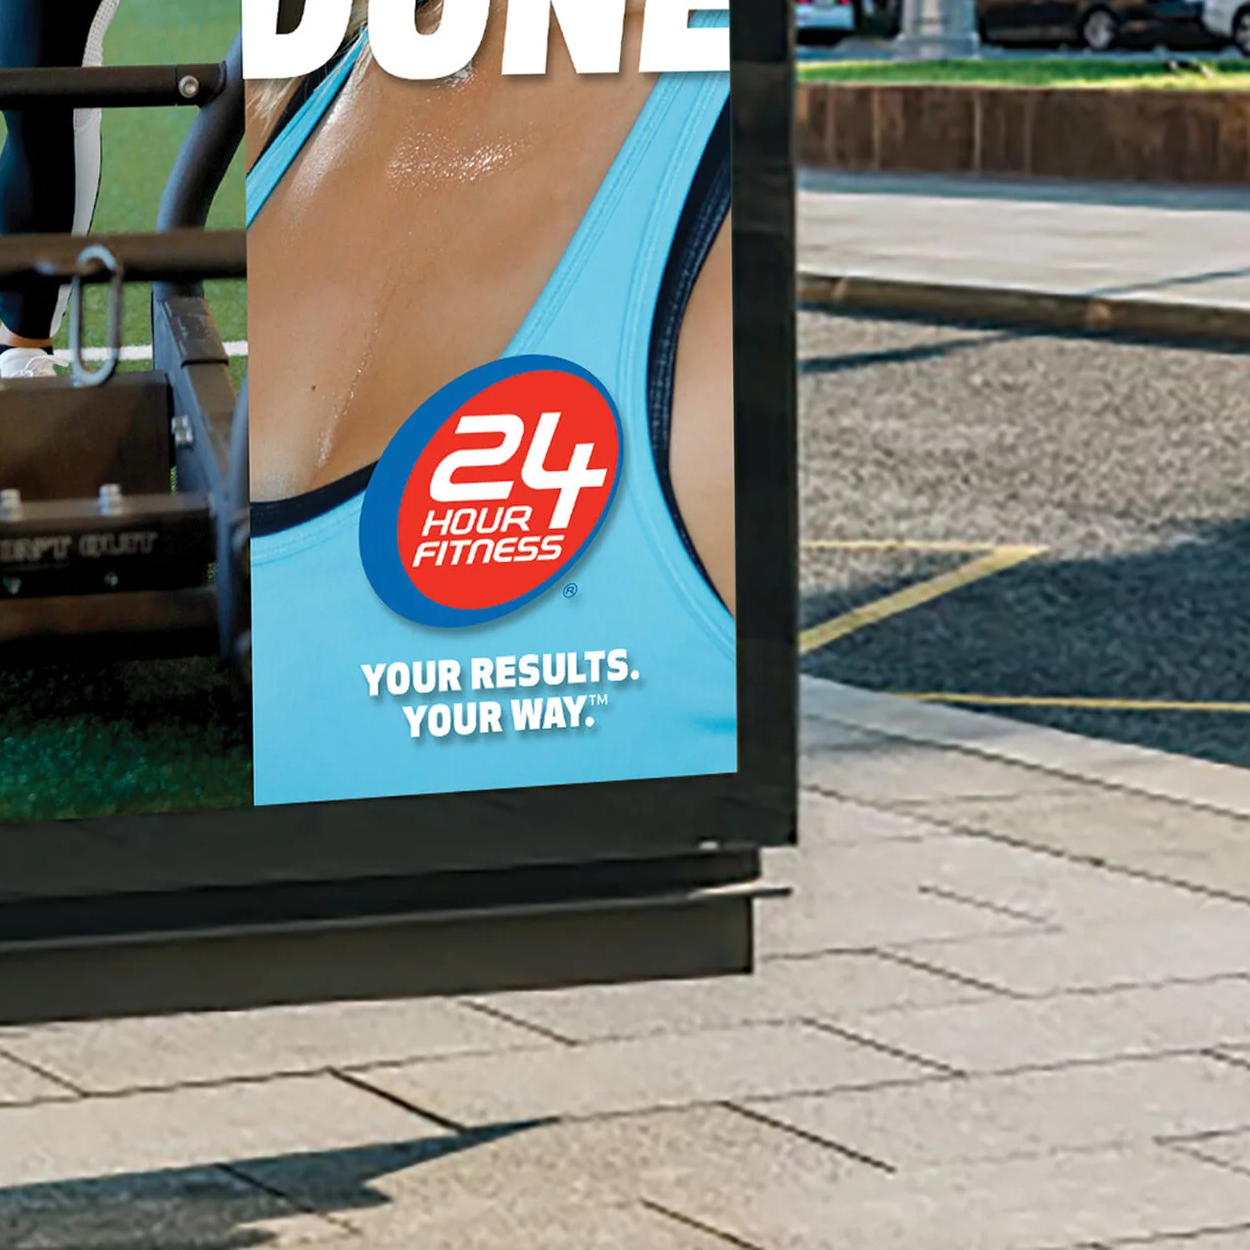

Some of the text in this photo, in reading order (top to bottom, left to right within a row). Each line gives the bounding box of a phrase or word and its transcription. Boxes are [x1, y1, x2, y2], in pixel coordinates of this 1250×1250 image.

[429, 412, 609, 529] 24
[421, 505, 533, 537] HOUR
[412, 534, 565, 568] FITNESS
[361, 648, 640, 696] YOUR RESULTS.
[402, 701, 503, 738] YOUR
